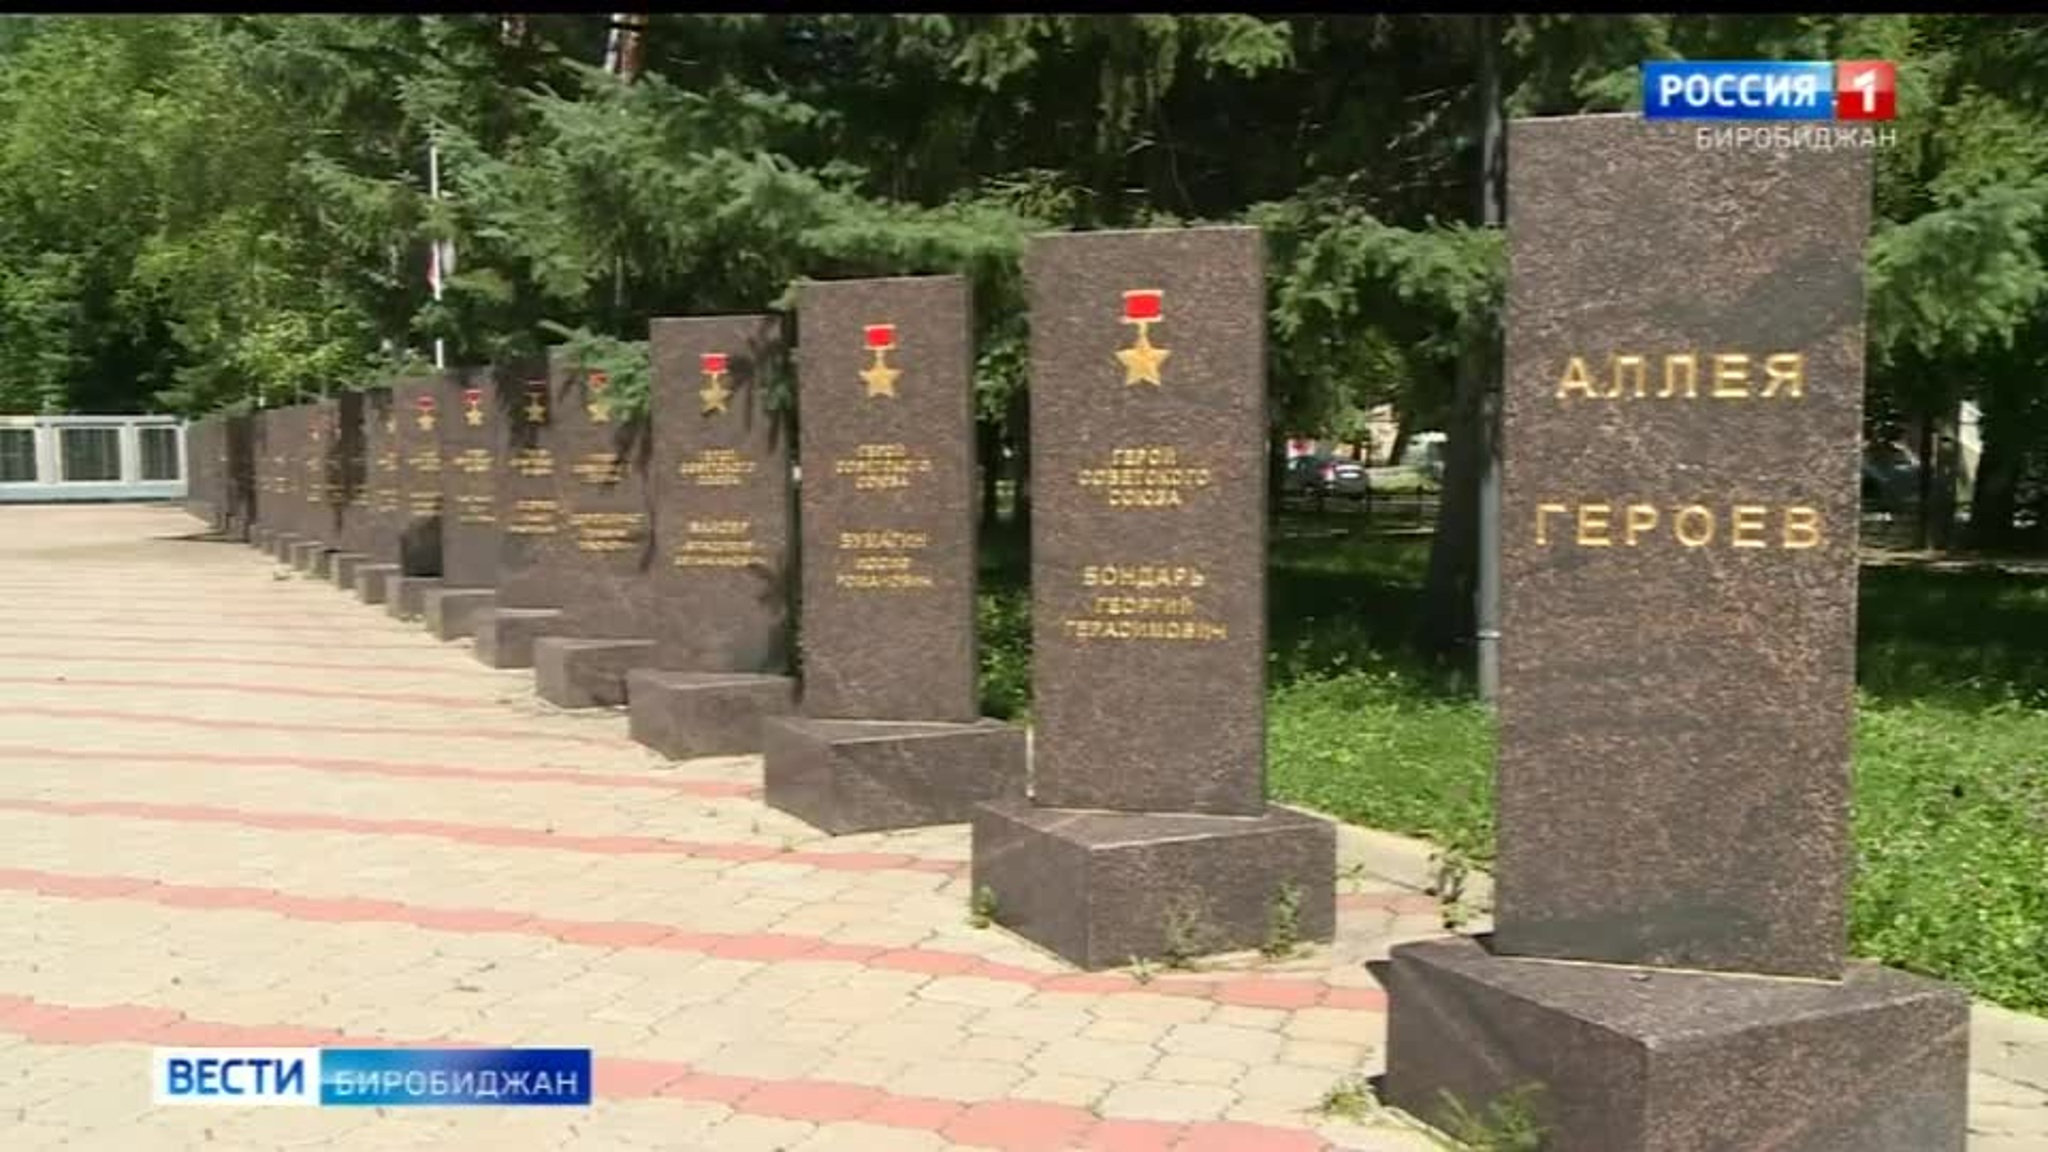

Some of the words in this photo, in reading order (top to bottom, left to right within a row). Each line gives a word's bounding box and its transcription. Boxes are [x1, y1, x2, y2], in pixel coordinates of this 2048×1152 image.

[1556, 352, 1806, 399] АЛЛЕЯ
[1077, 468, 1211, 487] СОВЕТСКОГО
[1108, 488, 1184, 506] СОЮЗА
[1534, 503, 1825, 549] ГЕРОЕВ
[1081, 565, 1206, 588] БОНДАРЬ
[1095, 595, 1196, 615] ГЕОРГИЙ
